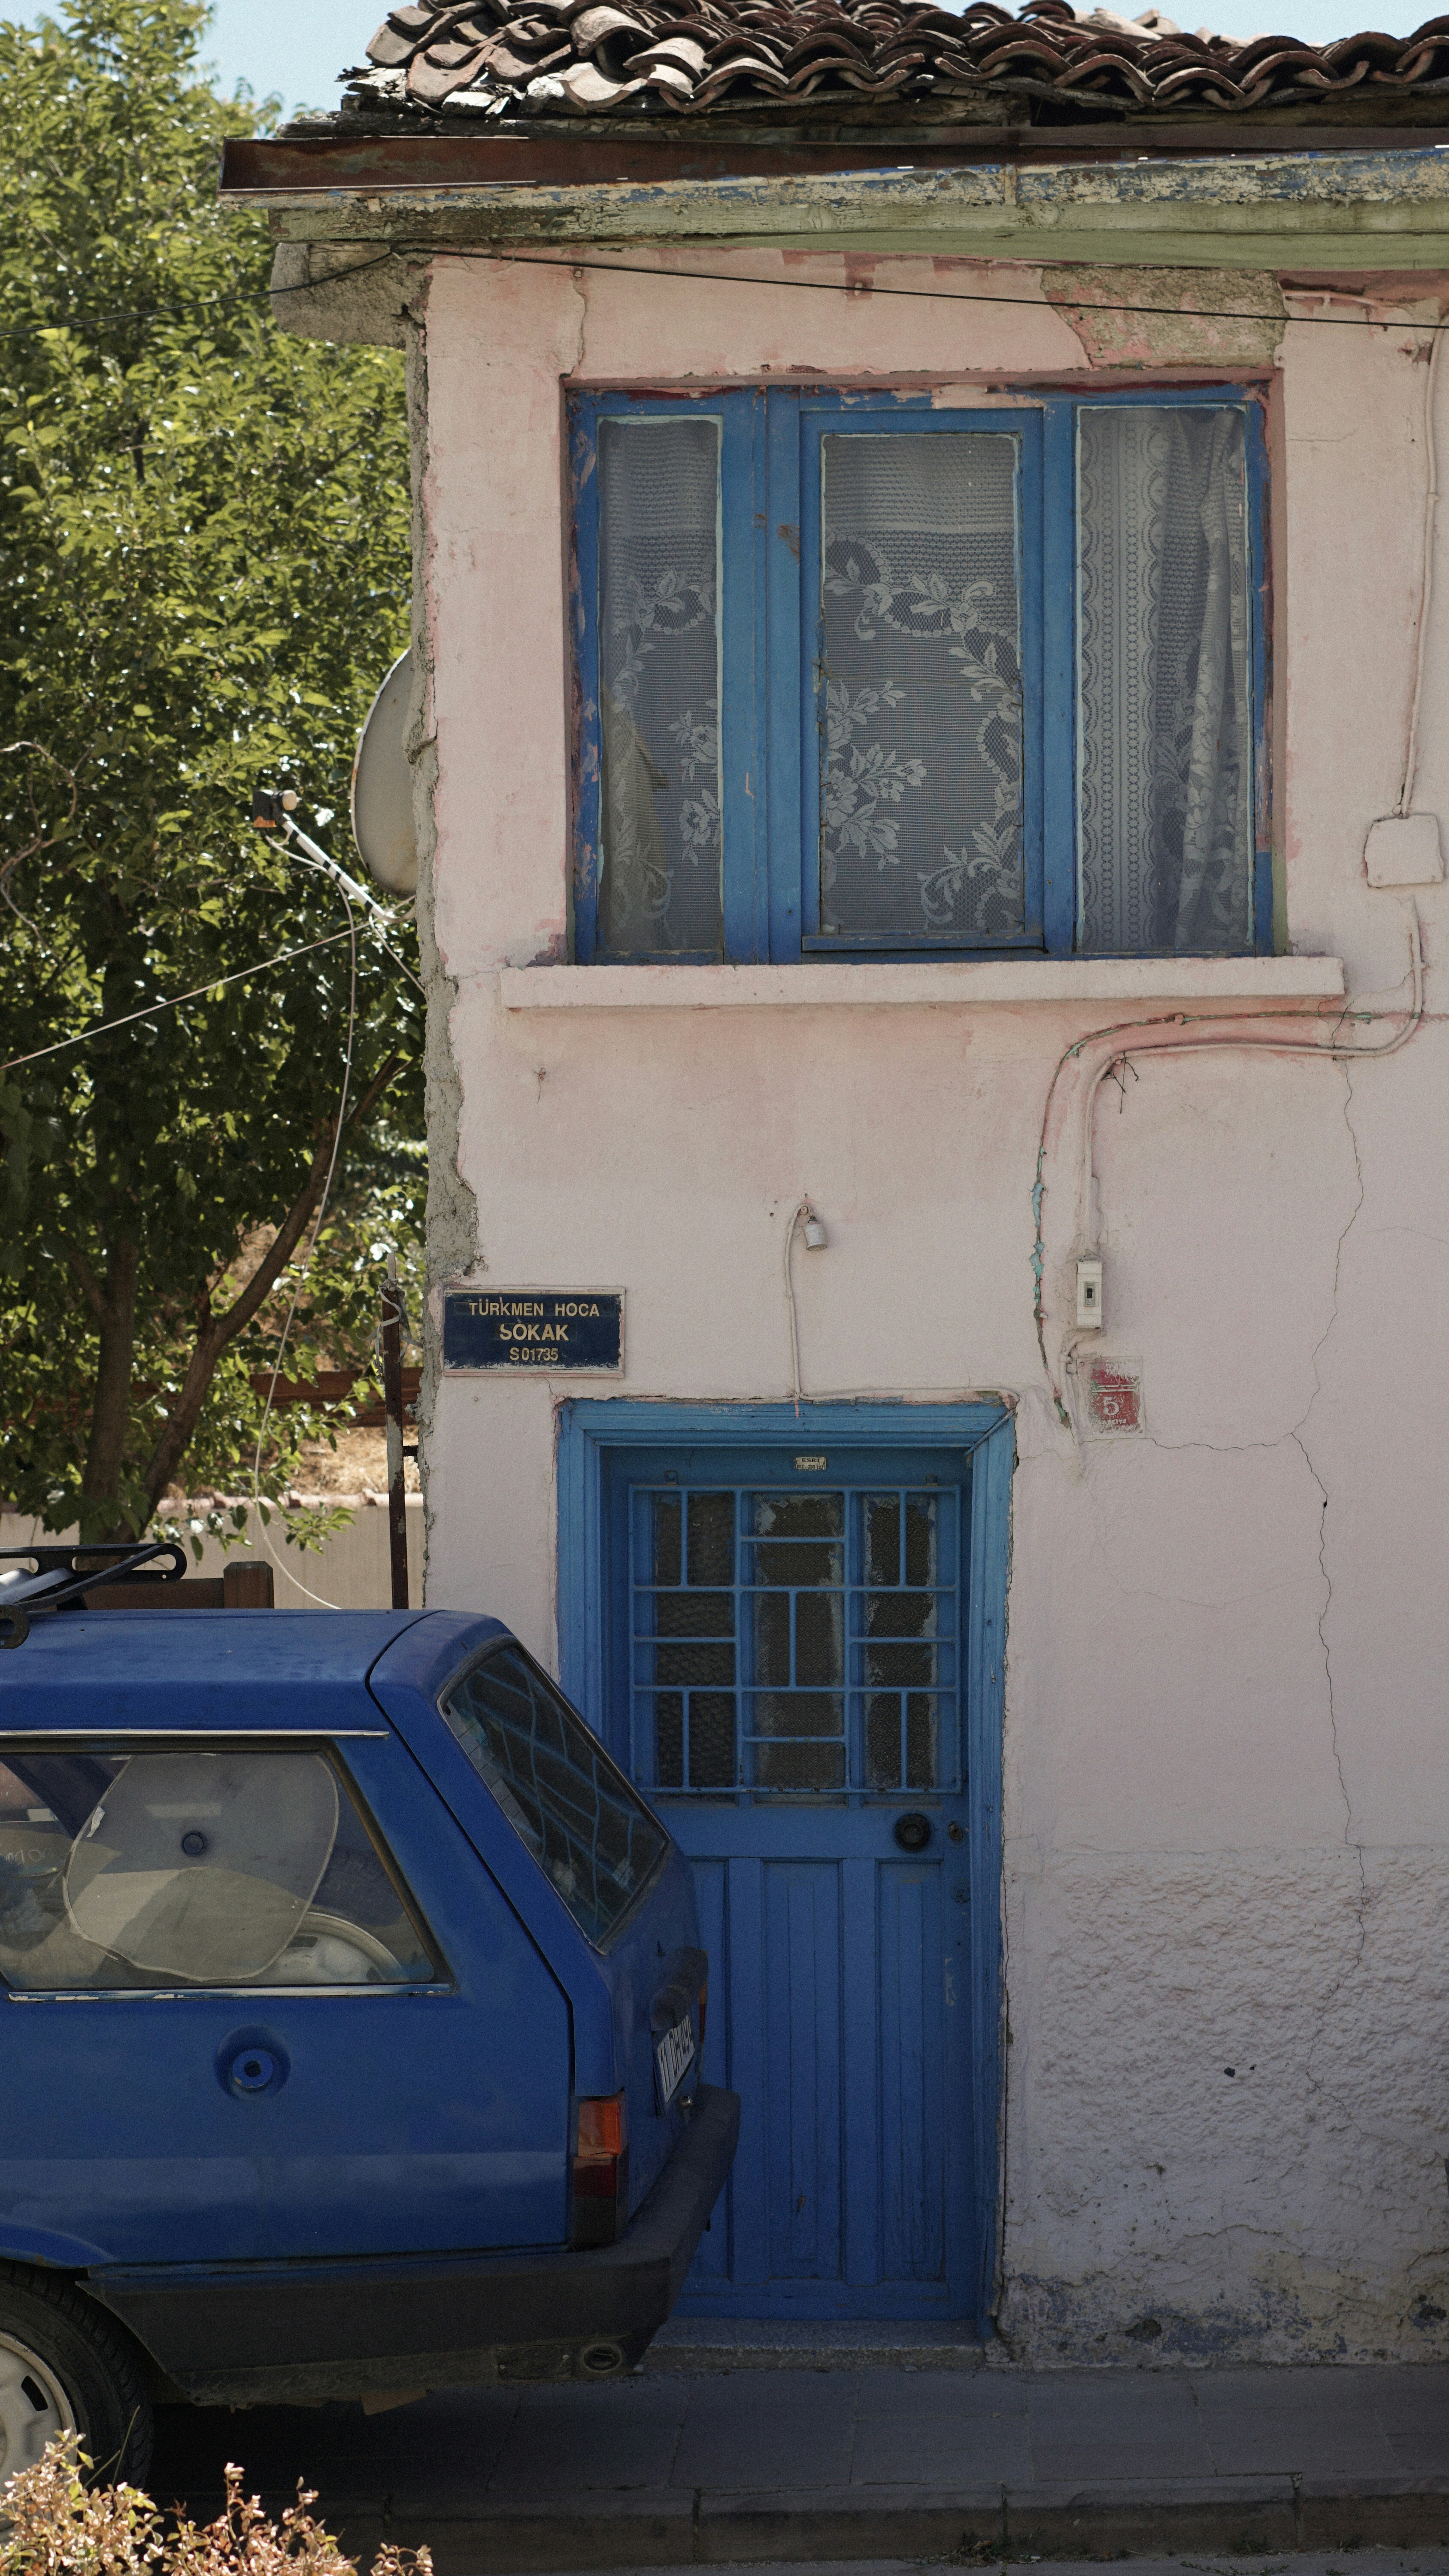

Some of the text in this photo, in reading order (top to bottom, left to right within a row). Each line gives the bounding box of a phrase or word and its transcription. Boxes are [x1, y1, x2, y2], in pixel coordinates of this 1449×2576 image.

[469, 1298, 600, 1317] TÜRKMEN HOCA
[500, 1324, 569, 1341] SOKAK
[1103, 1396, 1119, 1416] 5
[660, 2042, 670, 2092] 11
